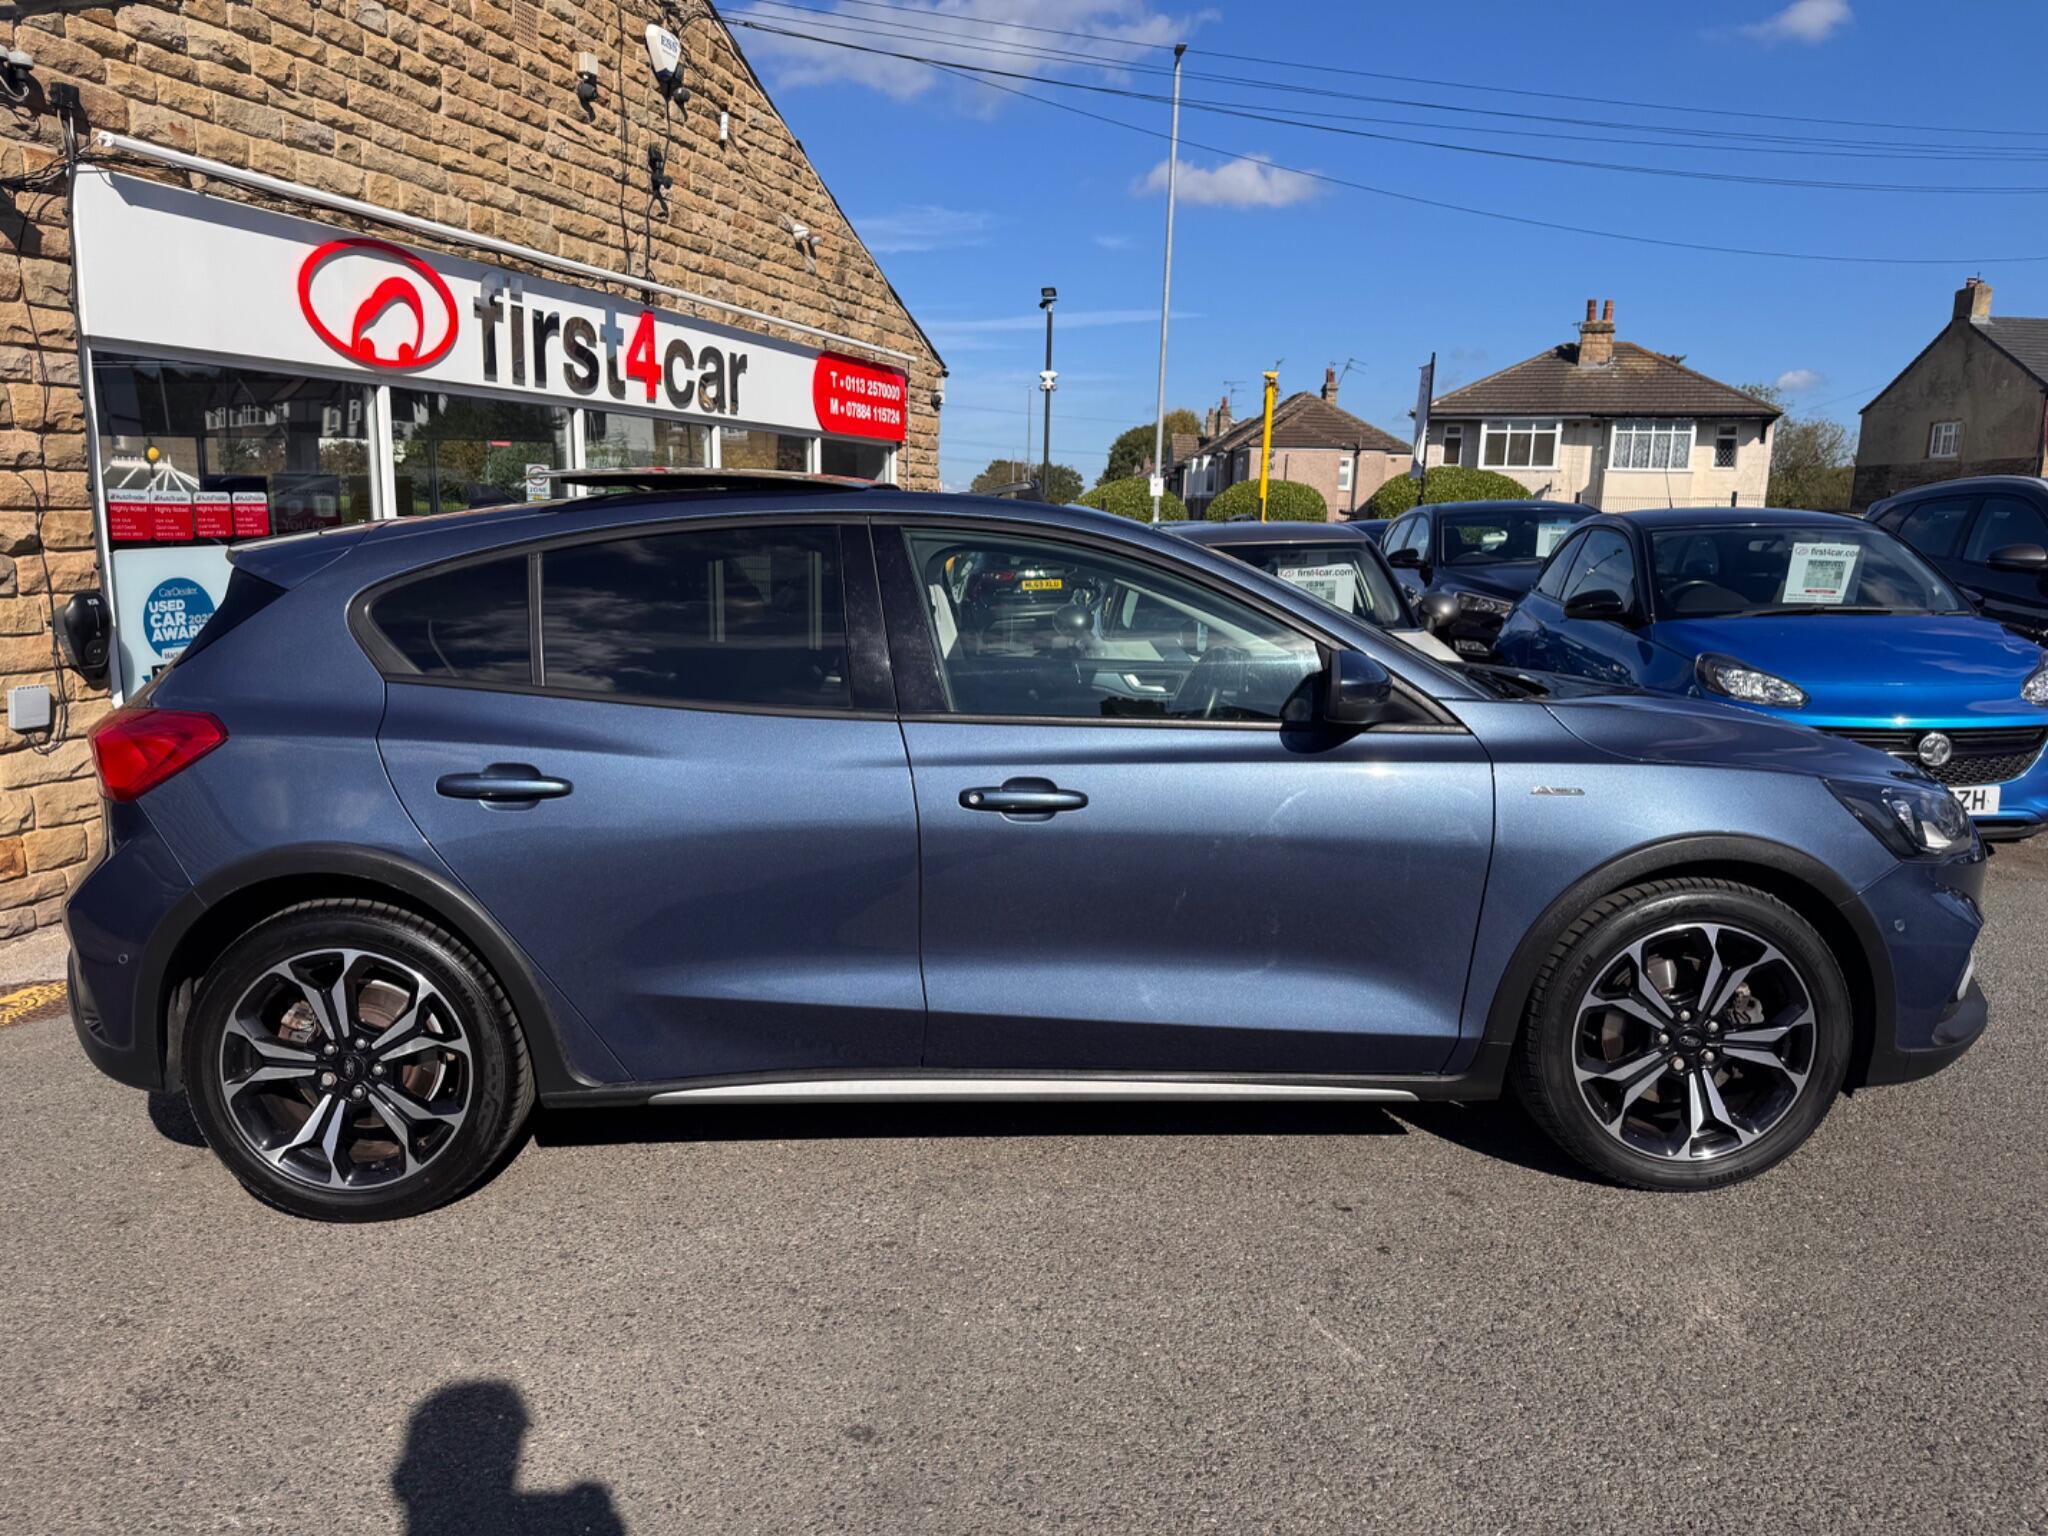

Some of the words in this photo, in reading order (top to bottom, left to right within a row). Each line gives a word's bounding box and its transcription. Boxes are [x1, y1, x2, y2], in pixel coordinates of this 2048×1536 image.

[473, 271, 748, 416] first4car
[829, 370, 838, 388] T
[845, 375, 865, 394] 0113
[829, 397, 839, 415] M
[1297, 568, 1354, 577] first4car.com
[148, 599, 186, 613] USED
[150, 611, 187, 628] CAR
